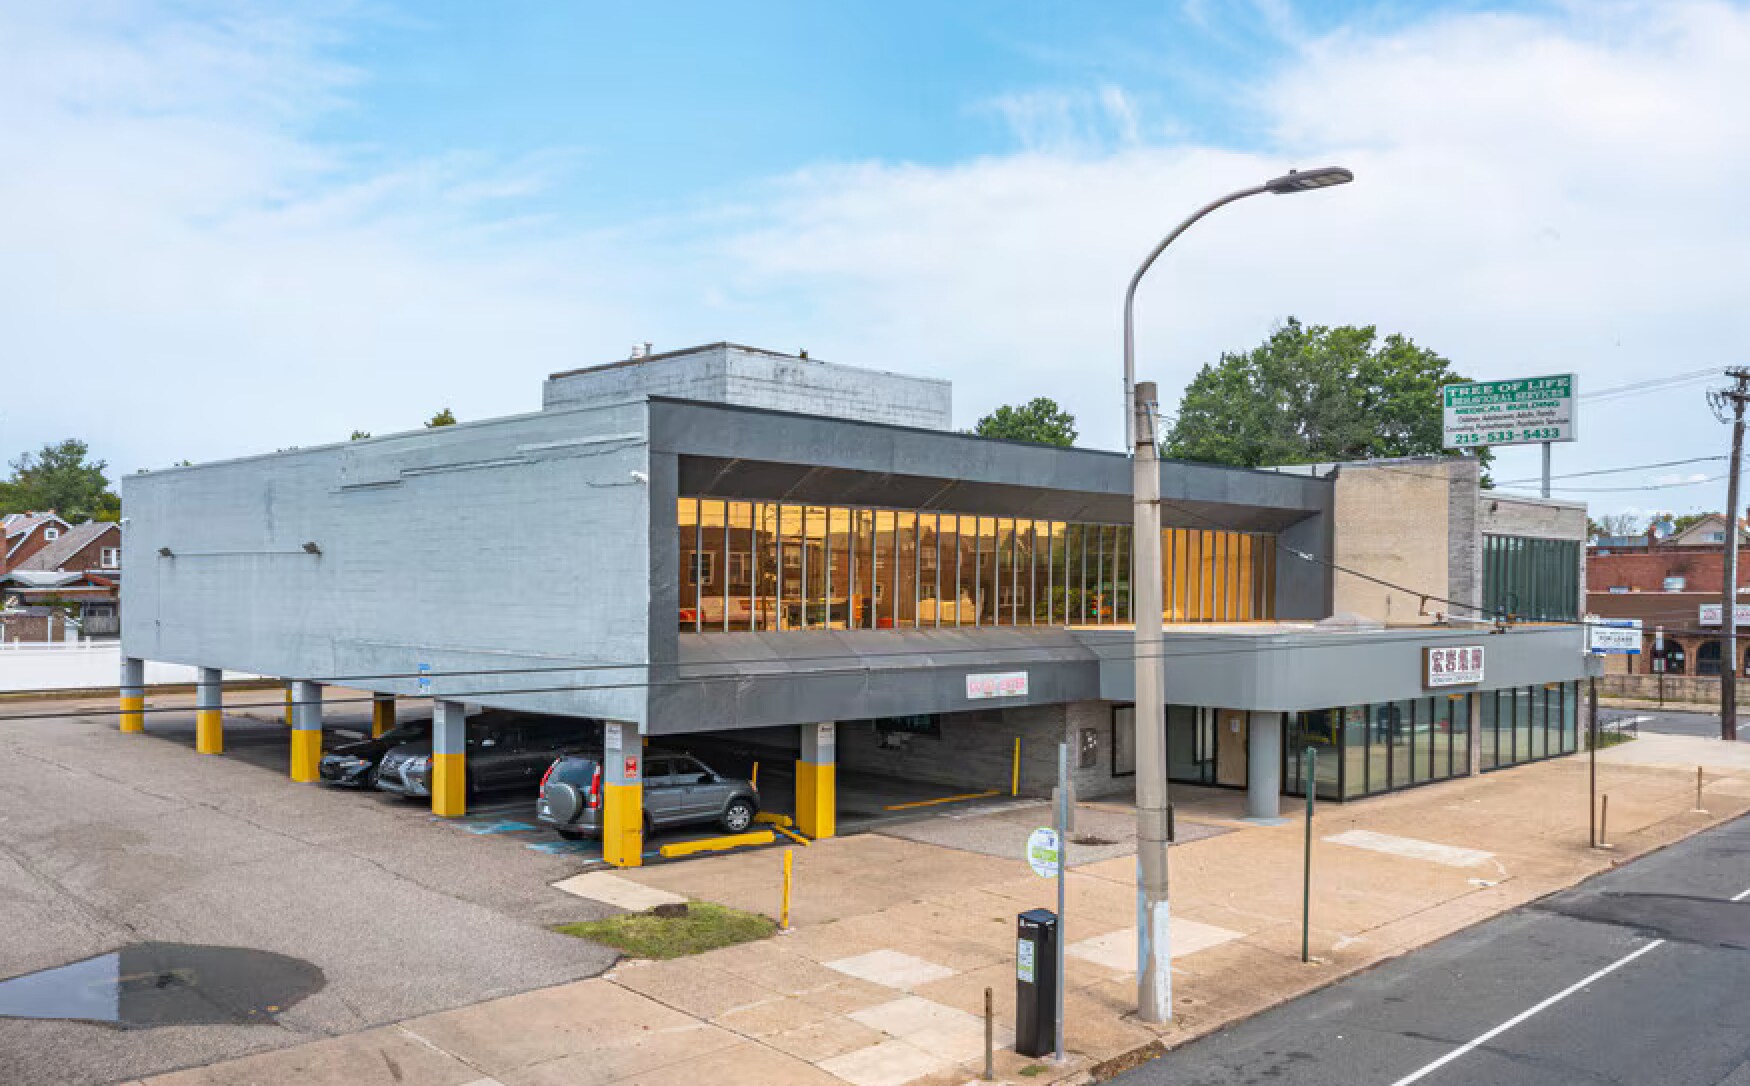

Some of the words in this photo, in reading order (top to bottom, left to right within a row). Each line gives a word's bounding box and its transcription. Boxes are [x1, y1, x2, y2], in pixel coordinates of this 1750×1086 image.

[1447, 385, 1493, 397] TREE
[1499, 382, 1521, 392] OF
[1528, 378, 1569, 390] LIFE
[1516, 390, 1564, 400] SERVICES
[1456, 406, 1501, 414] MEDICAL
[1507, 401, 1560, 410] BUILDING
[1455, 428, 1560, 444] 215-533-5433
[1613, 635, 1633, 643] LEASE
